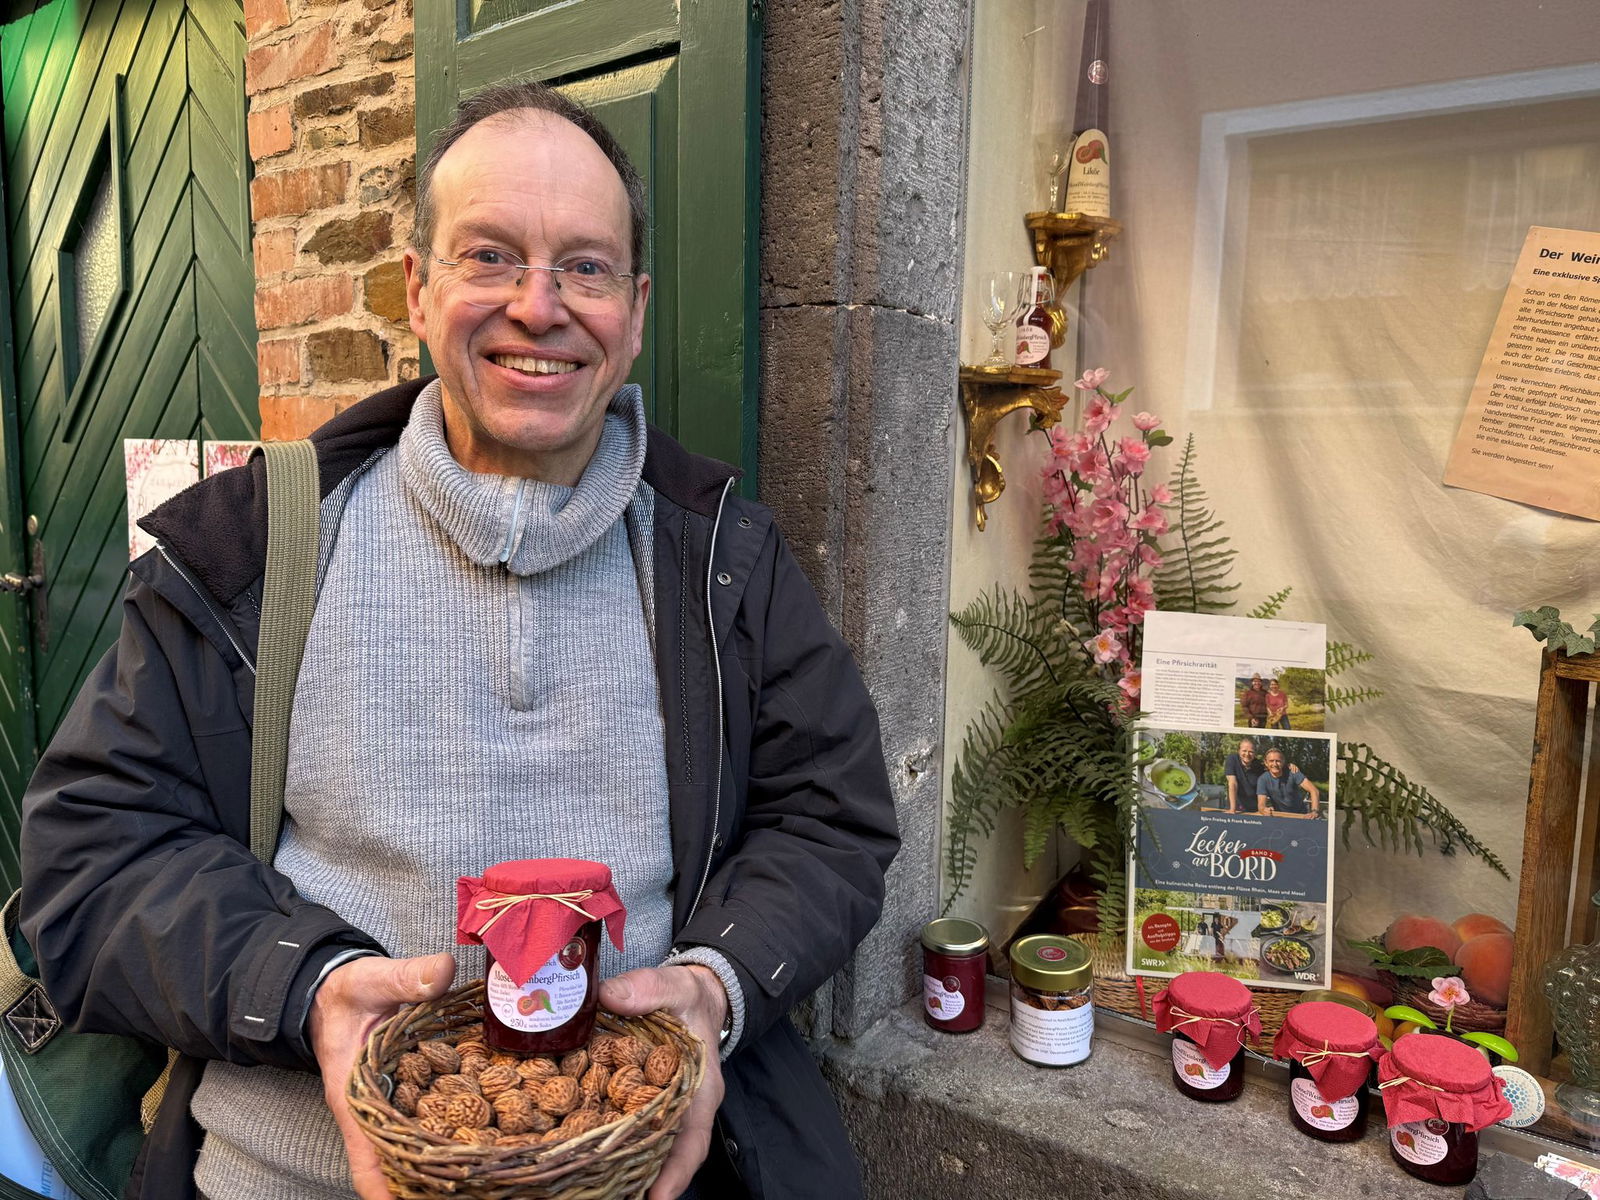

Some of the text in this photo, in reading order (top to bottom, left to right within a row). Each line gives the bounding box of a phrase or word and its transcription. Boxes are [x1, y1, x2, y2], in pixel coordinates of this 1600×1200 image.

[1539, 248, 1564, 260] Der
[1532, 268, 1550, 276] Eine
[1552, 271, 1590, 282] exklusive
[1525, 288, 1545, 296] Schon
[1560, 302, 1579, 310] Mosel
[1534, 308, 1574, 320] Pfirsichsorte
[1516, 315, 1562, 327] Jahrhunderten
[1564, 321, 1595, 332] angebaut
[1531, 326, 1570, 337] Renaissance
[1510, 332, 1534, 342] Früchte
[1536, 337, 1556, 345] haben
[1506, 342, 1532, 350] geistern
[1512, 362, 1552, 373] wunderbares
[1554, 367, 1582, 378] Erlebnis,
[1496, 374, 1518, 382] Unsere
[1521, 378, 1556, 390] kernechten
[1503, 393, 1524, 402] Anbau
[1525, 398, 1547, 407] erfolgt
[1549, 401, 1581, 412] biologisch
[1576, 397, 1596, 406] haben
[1481, 416, 1504, 425] tember
[1508, 422, 1535, 432] geerntet
[1484, 408, 1529, 422] handverlesene
[1530, 416, 1554, 427] Früchte
[1569, 424, 1598, 435] eigenem
[1500, 438, 1529, 449] exklusive
[1548, 438, 1591, 452] Pfirsichbrand
[1482, 451, 1504, 460] werden
[1506, 455, 1536, 467] begeistert
[1172, 659, 1217, 668] Pfirsichrarität
[1184, 826, 1246, 856] Lecker
[1192, 853, 1276, 881] an BORD
[1141, 958, 1158, 966] SWR
[1294, 972, 1316, 980] WDR
